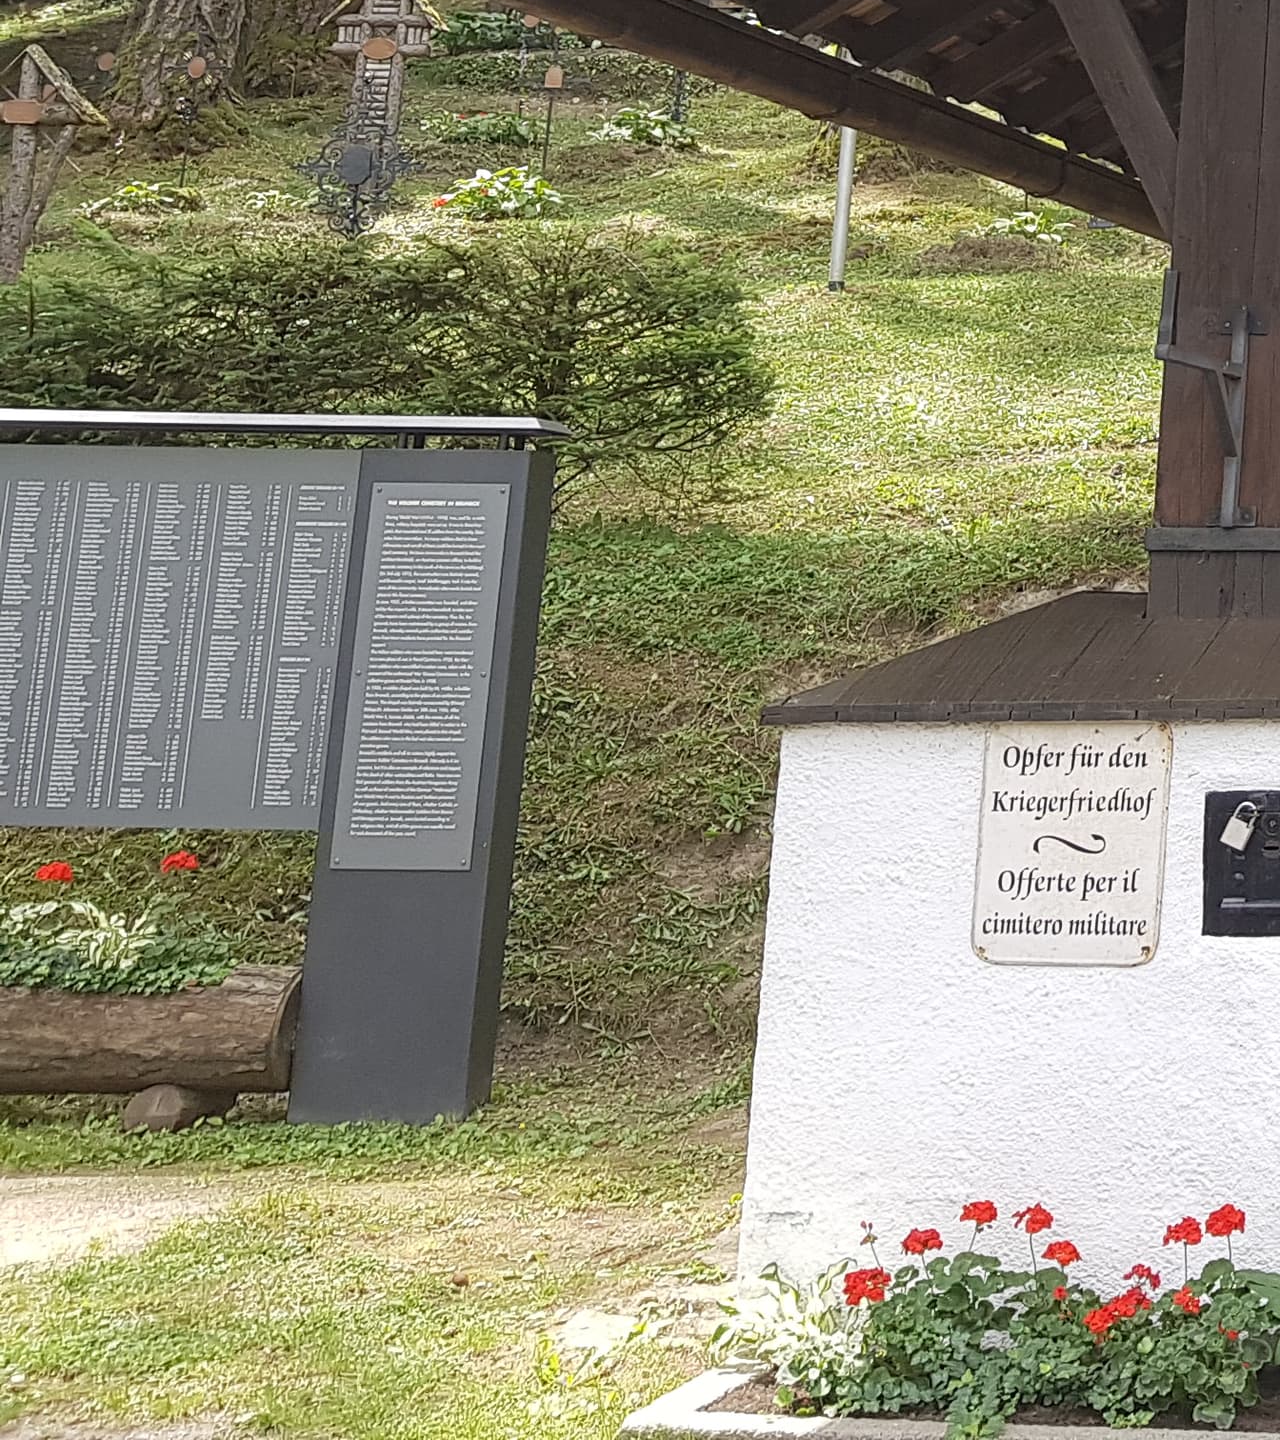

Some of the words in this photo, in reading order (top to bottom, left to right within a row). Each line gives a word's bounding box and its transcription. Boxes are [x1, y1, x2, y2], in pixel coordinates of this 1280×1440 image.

[1003, 743, 1065, 776] Opfer
[1064, 743, 1104, 776] für
[1108, 743, 1149, 769] den
[991, 787, 1158, 821] Kriegerfriedhof
[997, 867, 1077, 901] Offerte
[1080, 871, 1118, 902] per
[1122, 867, 1141, 893] il
[982, 911, 1064, 935] cimitero
[1068, 910, 1148, 936] militare
